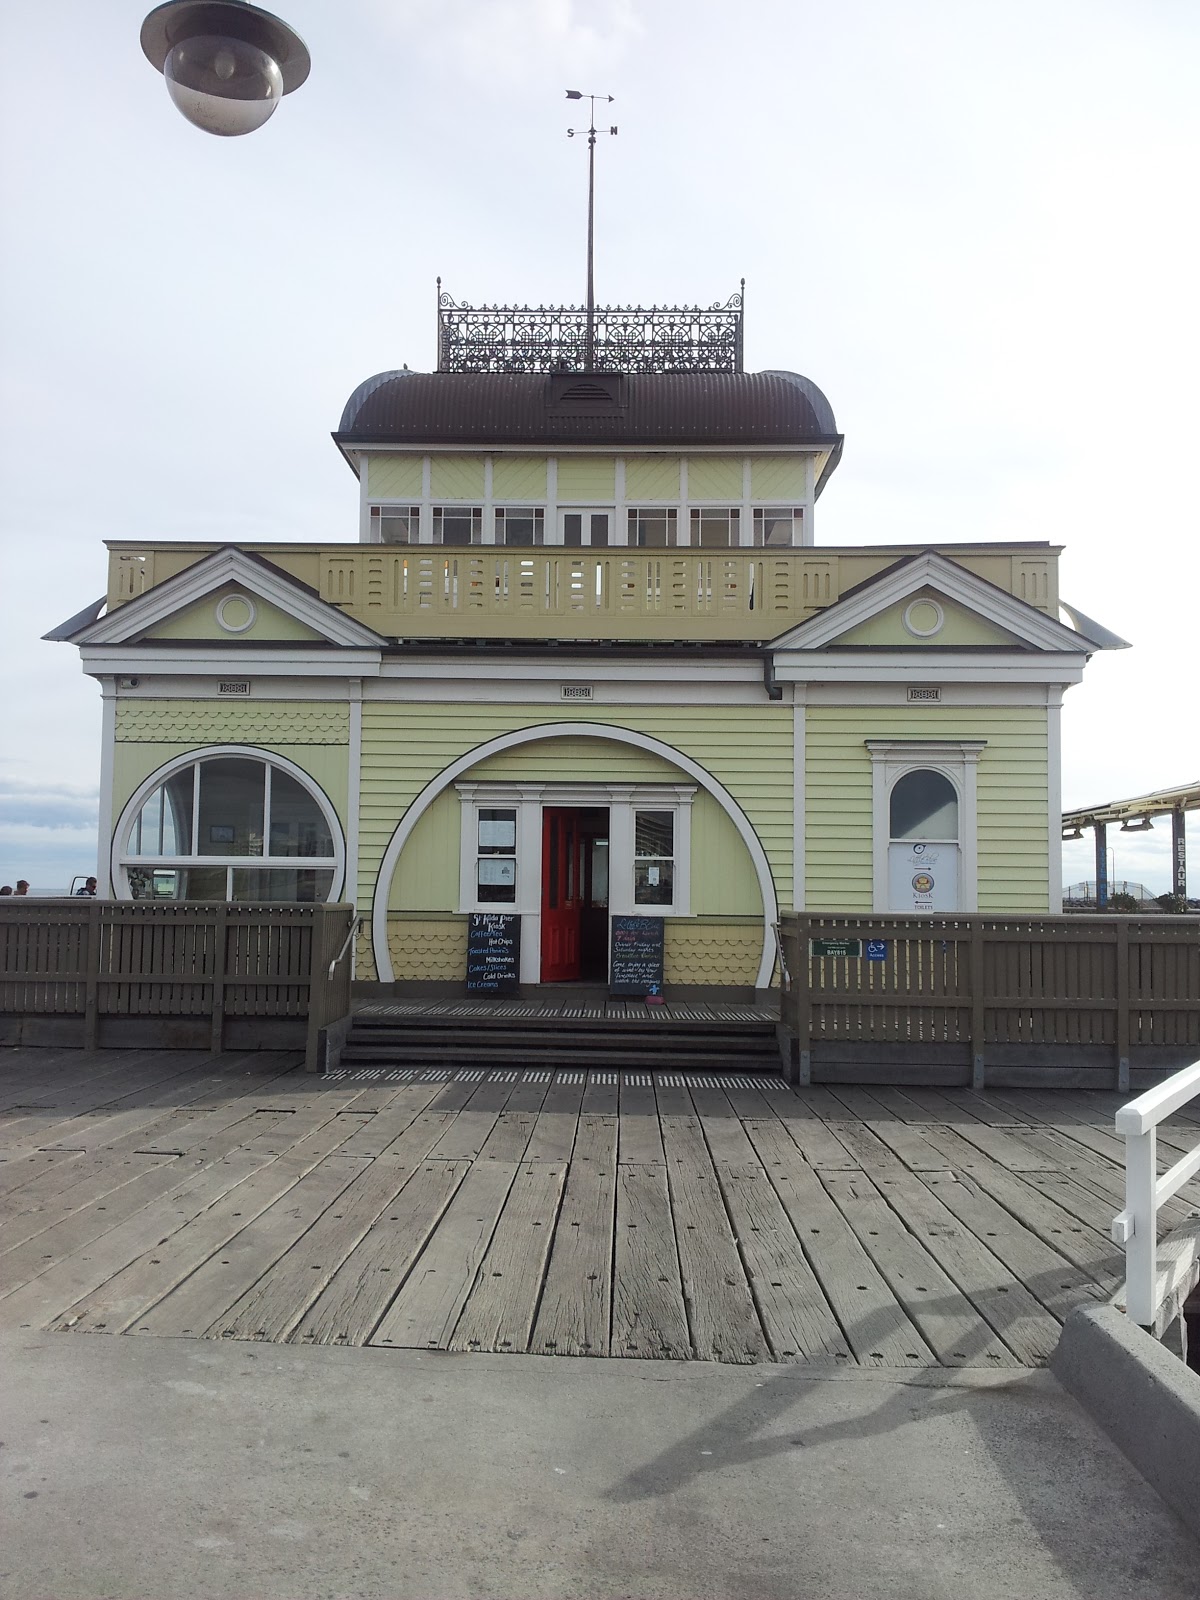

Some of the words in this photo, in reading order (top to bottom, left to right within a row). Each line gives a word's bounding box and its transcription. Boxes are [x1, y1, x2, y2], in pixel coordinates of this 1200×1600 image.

[567, 128, 574, 138] S
[610, 126, 618, 135] N
[482, 972, 497, 980] Cold
